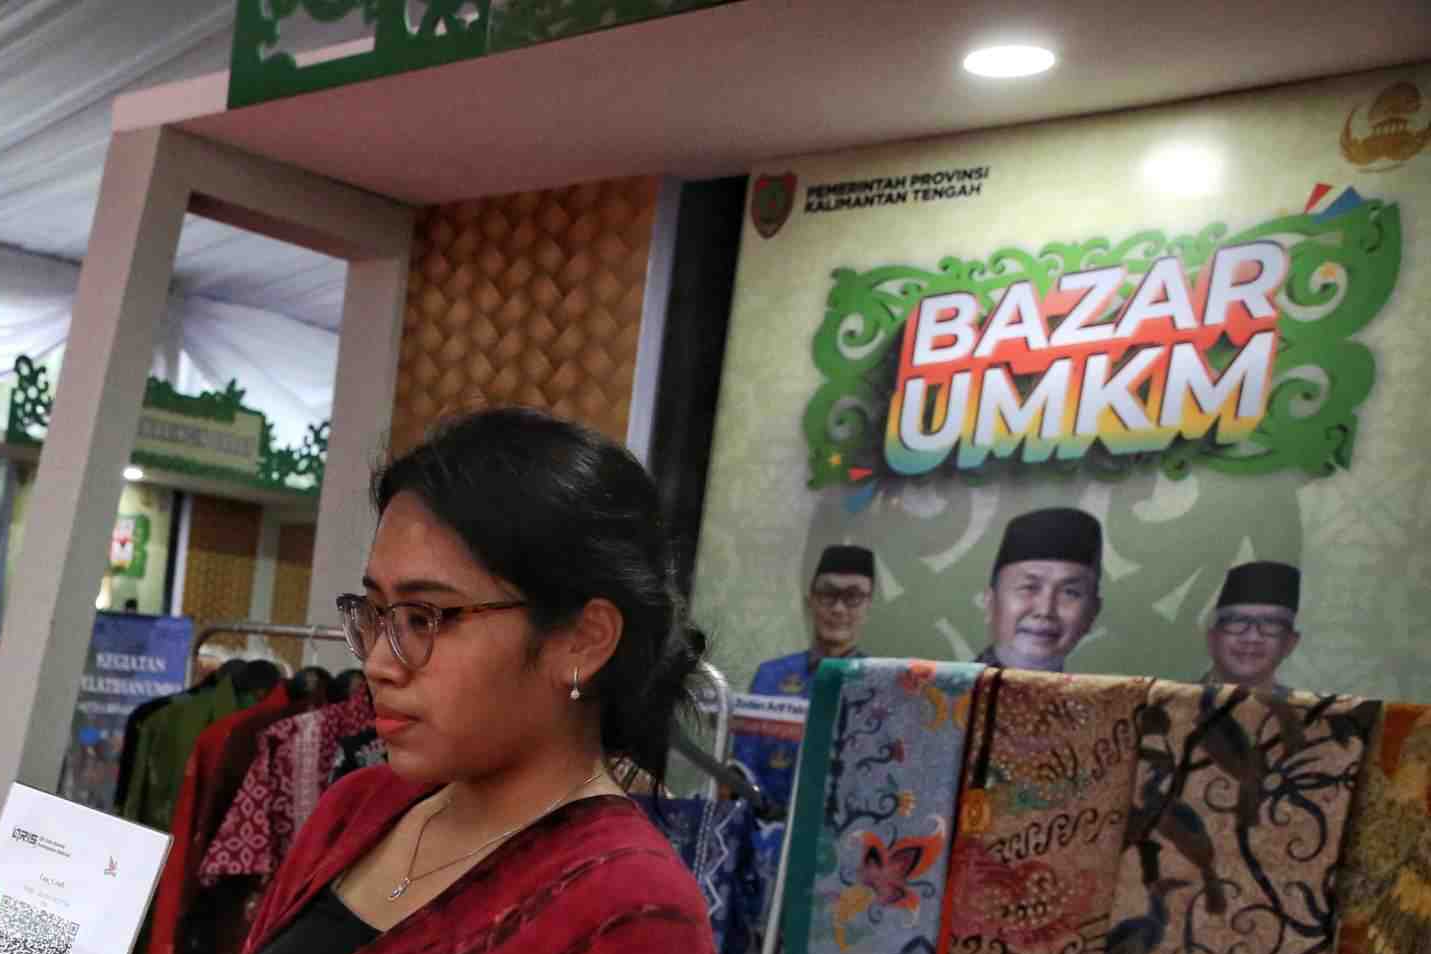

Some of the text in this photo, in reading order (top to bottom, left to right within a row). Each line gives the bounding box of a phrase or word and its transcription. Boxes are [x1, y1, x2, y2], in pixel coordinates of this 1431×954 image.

[804, 182, 982, 213] KALIMANTAN TENGAH
[807, 165, 990, 197] PEMERINTAH PROVINSI
[910, 240, 1288, 367] BAZAR
[896, 330, 1276, 454] UMKM
